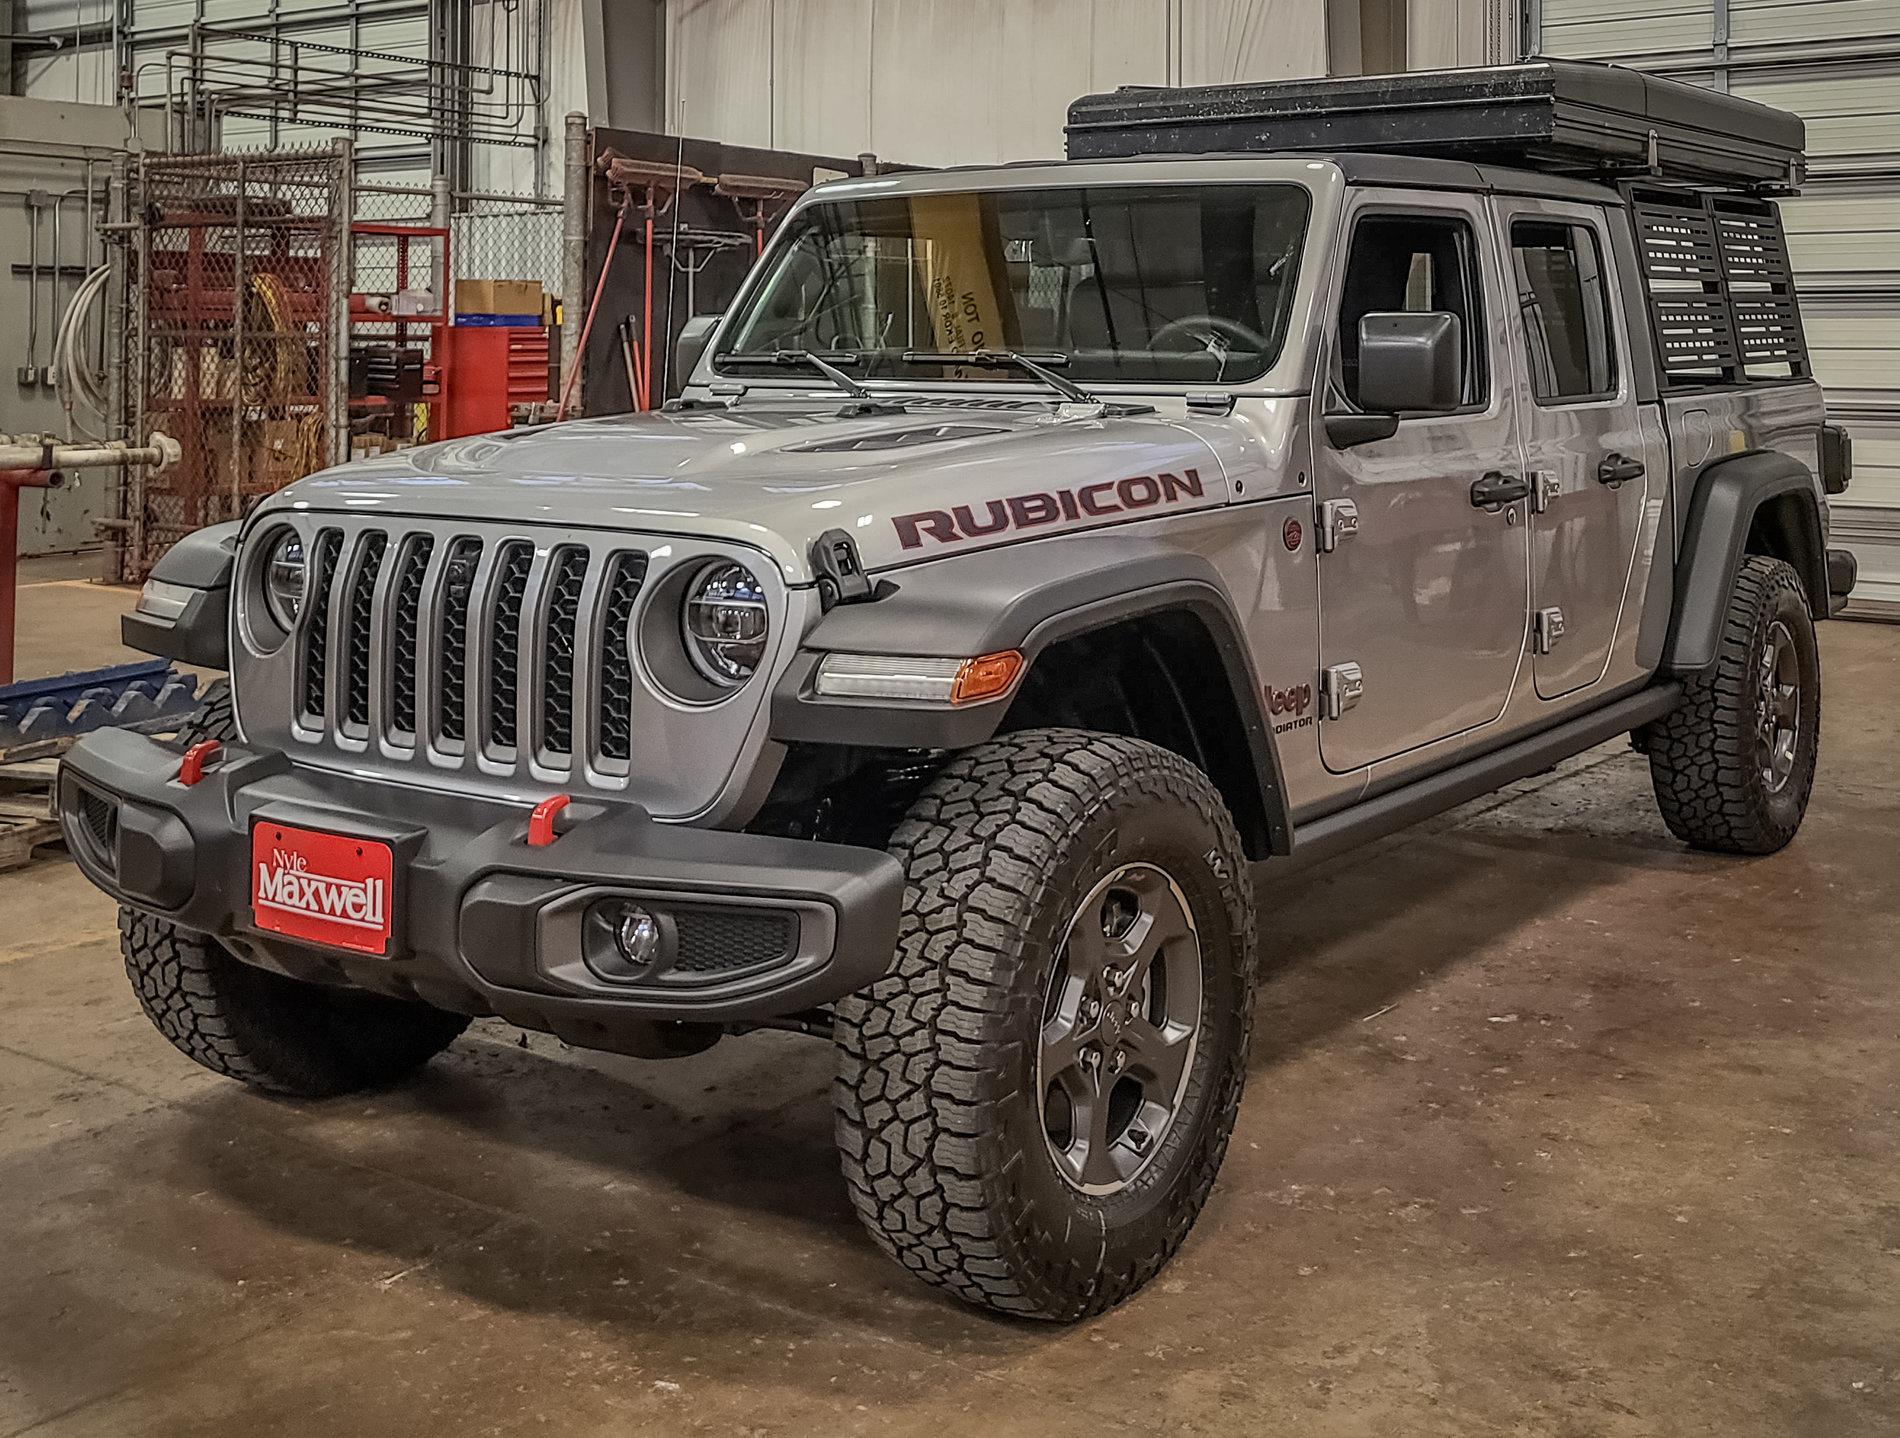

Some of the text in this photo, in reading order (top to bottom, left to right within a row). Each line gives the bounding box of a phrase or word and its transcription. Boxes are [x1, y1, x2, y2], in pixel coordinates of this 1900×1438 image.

[891, 468, 1205, 550] RUBICON
[1263, 684, 1311, 716] Jeep
[1273, 716, 1312, 734] DIATOR
[273, 848, 307, 873] Nyle
[258, 863, 384, 923] Maxwell
